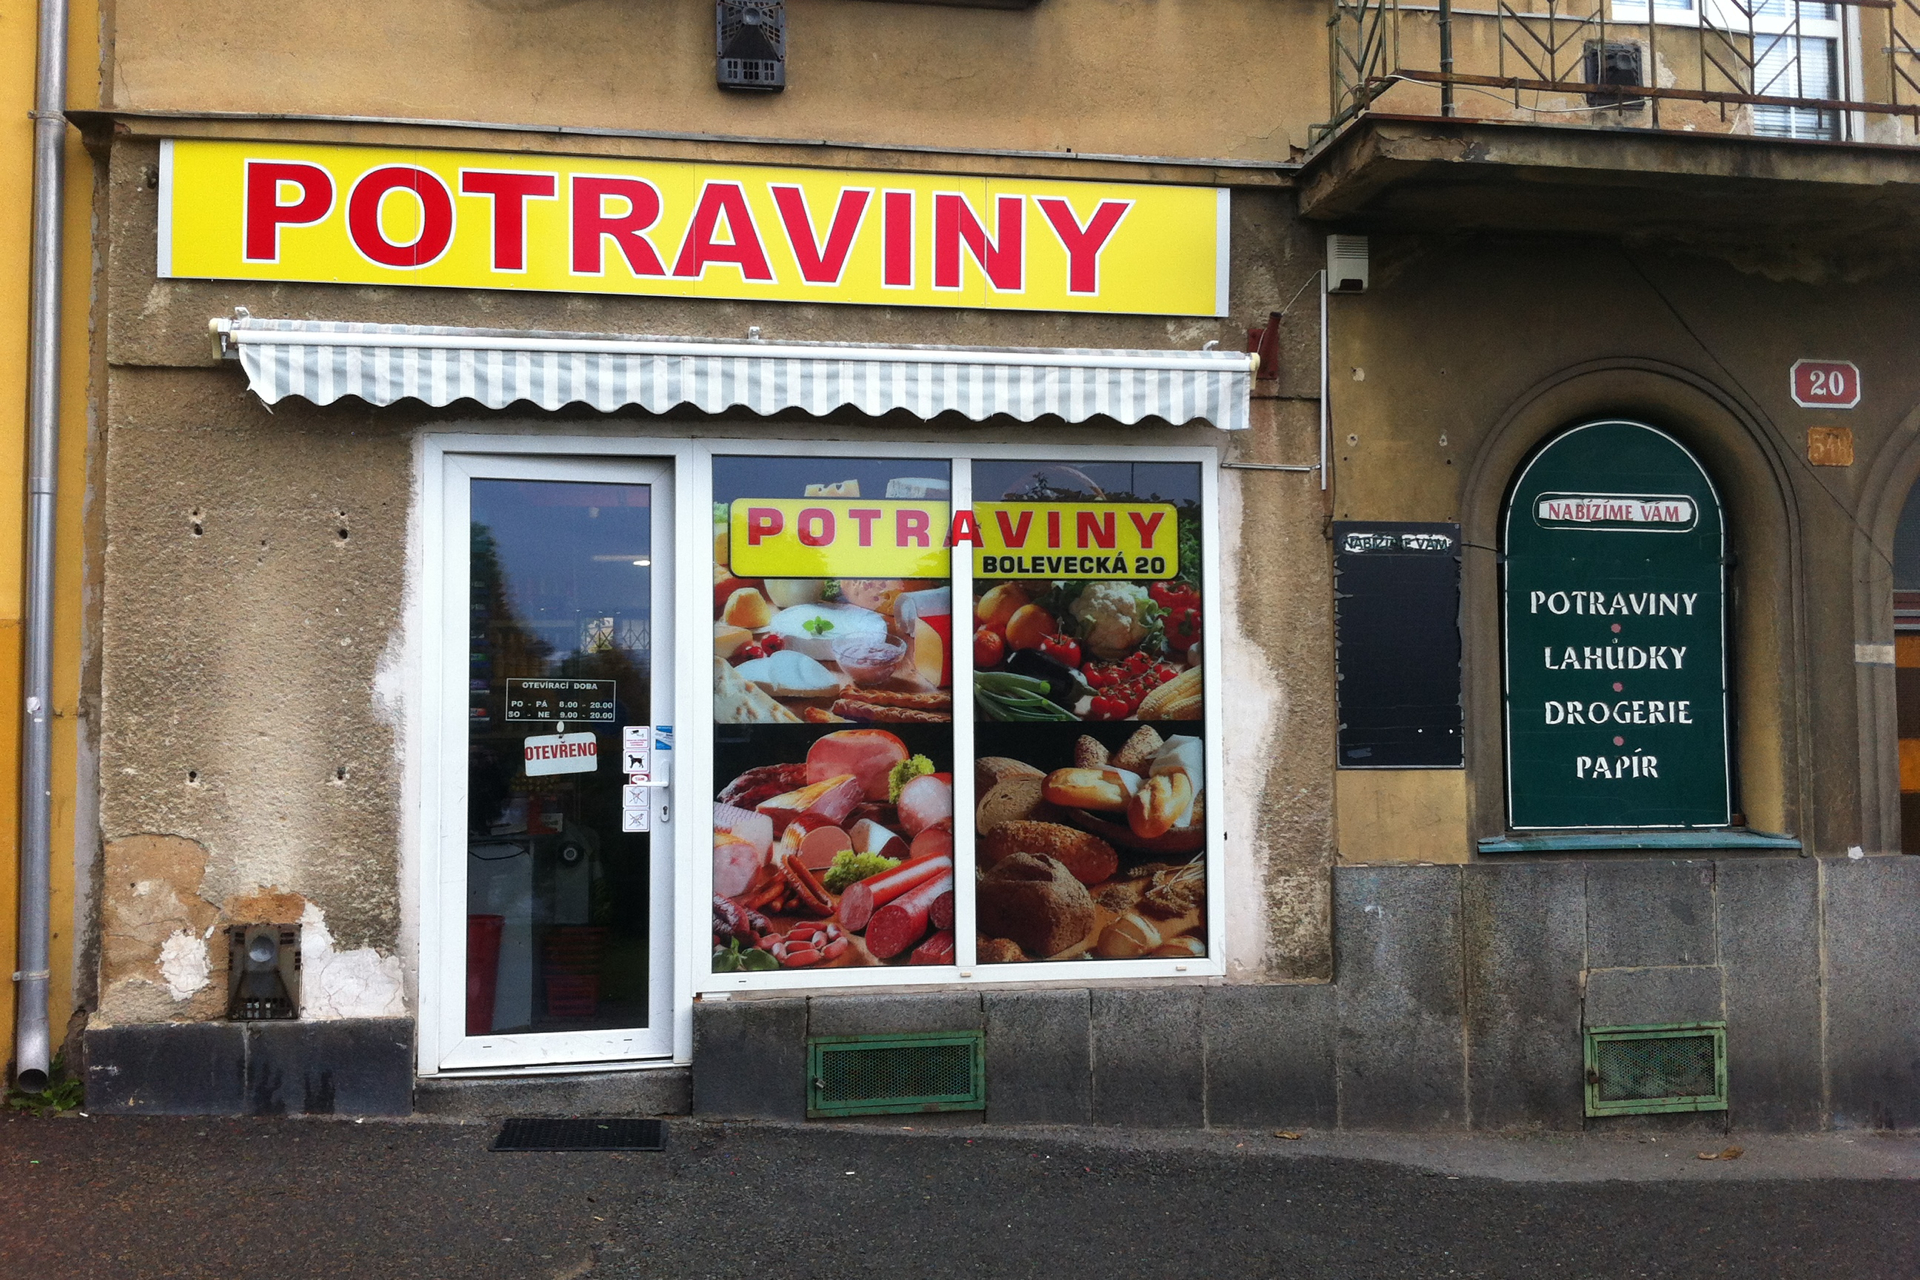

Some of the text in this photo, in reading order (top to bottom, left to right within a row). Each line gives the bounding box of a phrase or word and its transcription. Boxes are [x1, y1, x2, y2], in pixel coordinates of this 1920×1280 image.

[243, 158, 1134, 296] POTRAVINY
[1810, 370, 1845, 396] 20
[1549, 499, 1680, 522] NABÍZÍME VÁM
[747, 506, 1166, 550] POTRAVINY
[982, 551, 1166, 575] BOLEVECKÁ 20
[1530, 590, 1698, 616] POTRAVINY
[1544, 637, 1687, 670] LAHŮDKY
[522, 681, 569, 689] OTEVÍRACÍ
[536, 699, 548, 707] PÁ
[559, 701, 578, 709] 8.00
[590, 701, 613, 709] 20.00
[559, 711, 578, 719] 9.00
[1545, 701, 1693, 725] DROGERIE
[524, 740, 597, 761] OTEVŘENO
[1576, 747, 1659, 779] PAPÍR
